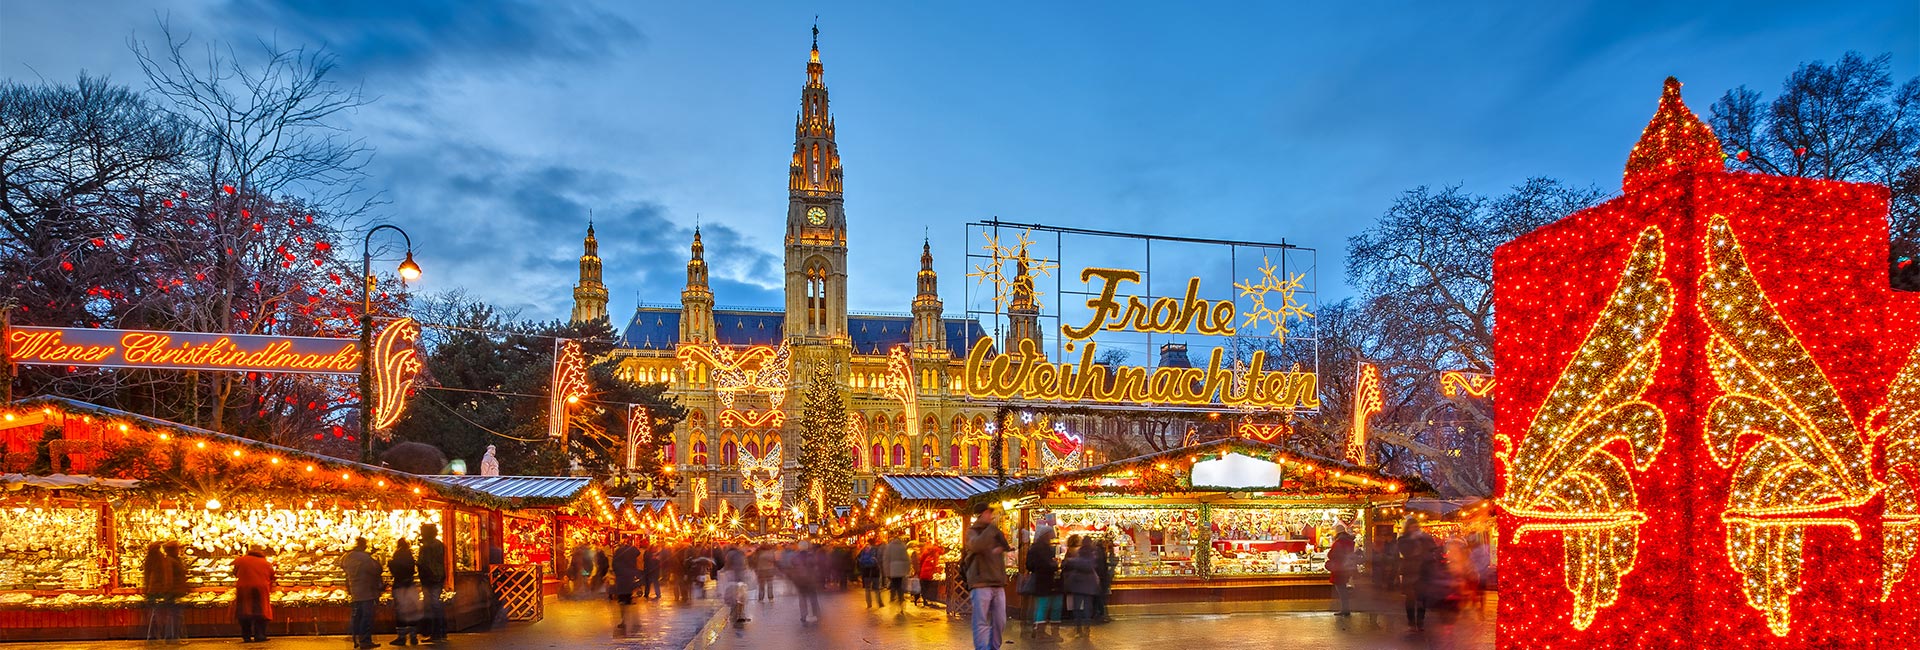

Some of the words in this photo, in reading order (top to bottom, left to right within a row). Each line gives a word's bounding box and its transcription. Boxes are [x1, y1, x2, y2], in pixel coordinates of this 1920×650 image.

[1062, 267, 1236, 339] Frohe
[10, 330, 115, 361] Wiener
[121, 333, 363, 371] Christkindlmarkt
[966, 335, 1319, 408] Weihnachten
